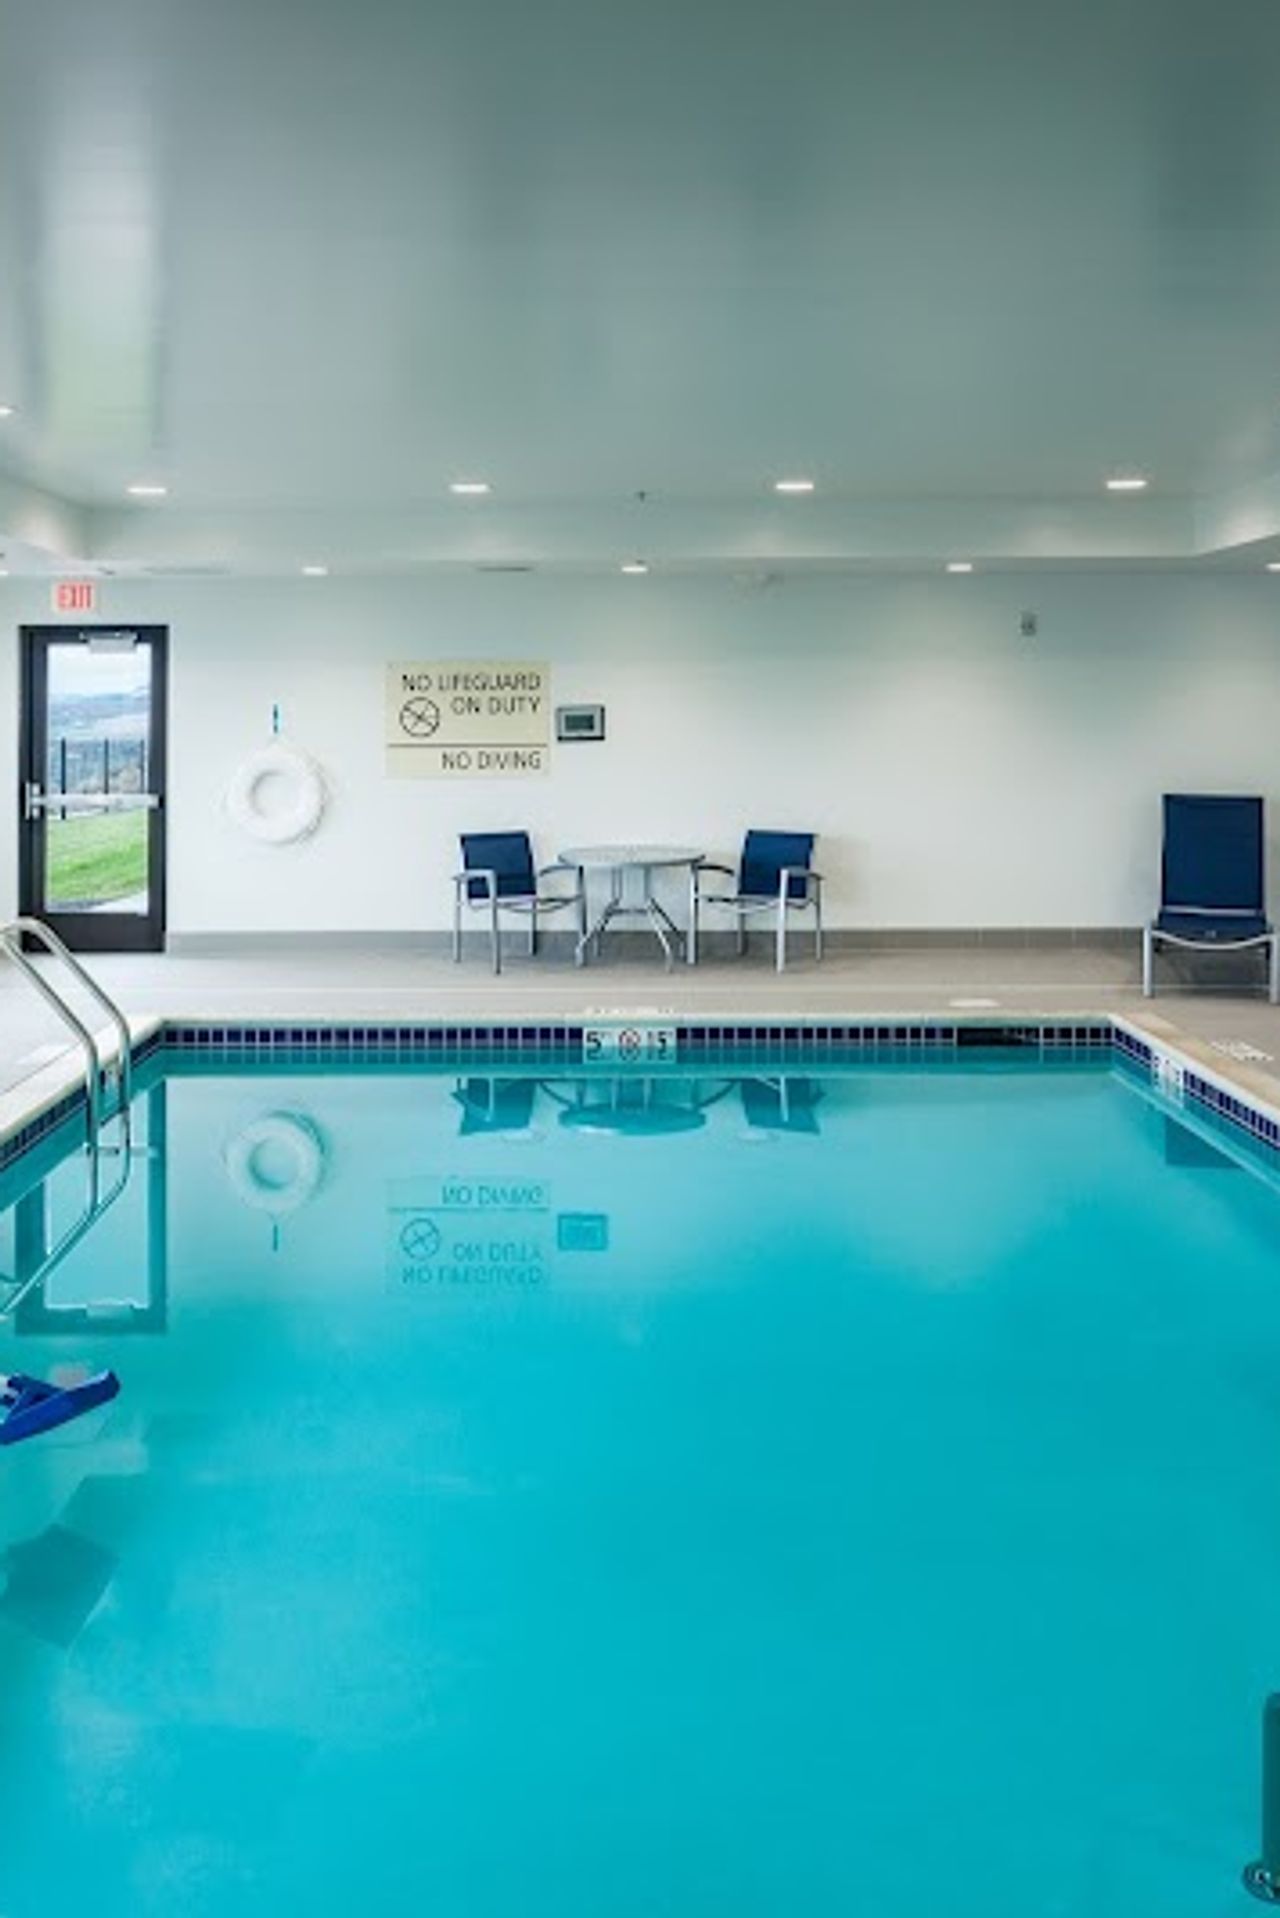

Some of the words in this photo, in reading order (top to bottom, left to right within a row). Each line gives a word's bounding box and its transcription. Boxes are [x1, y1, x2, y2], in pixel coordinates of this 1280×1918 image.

[58, 583, 92, 610] EXIT
[402, 672, 432, 691] NO
[438, 672, 541, 691] LIFEGUARD
[450, 695, 480, 714] ON
[488, 695, 541, 714] DUTY
[442, 750, 471, 769] NO
[478, 750, 541, 769] DIVING
